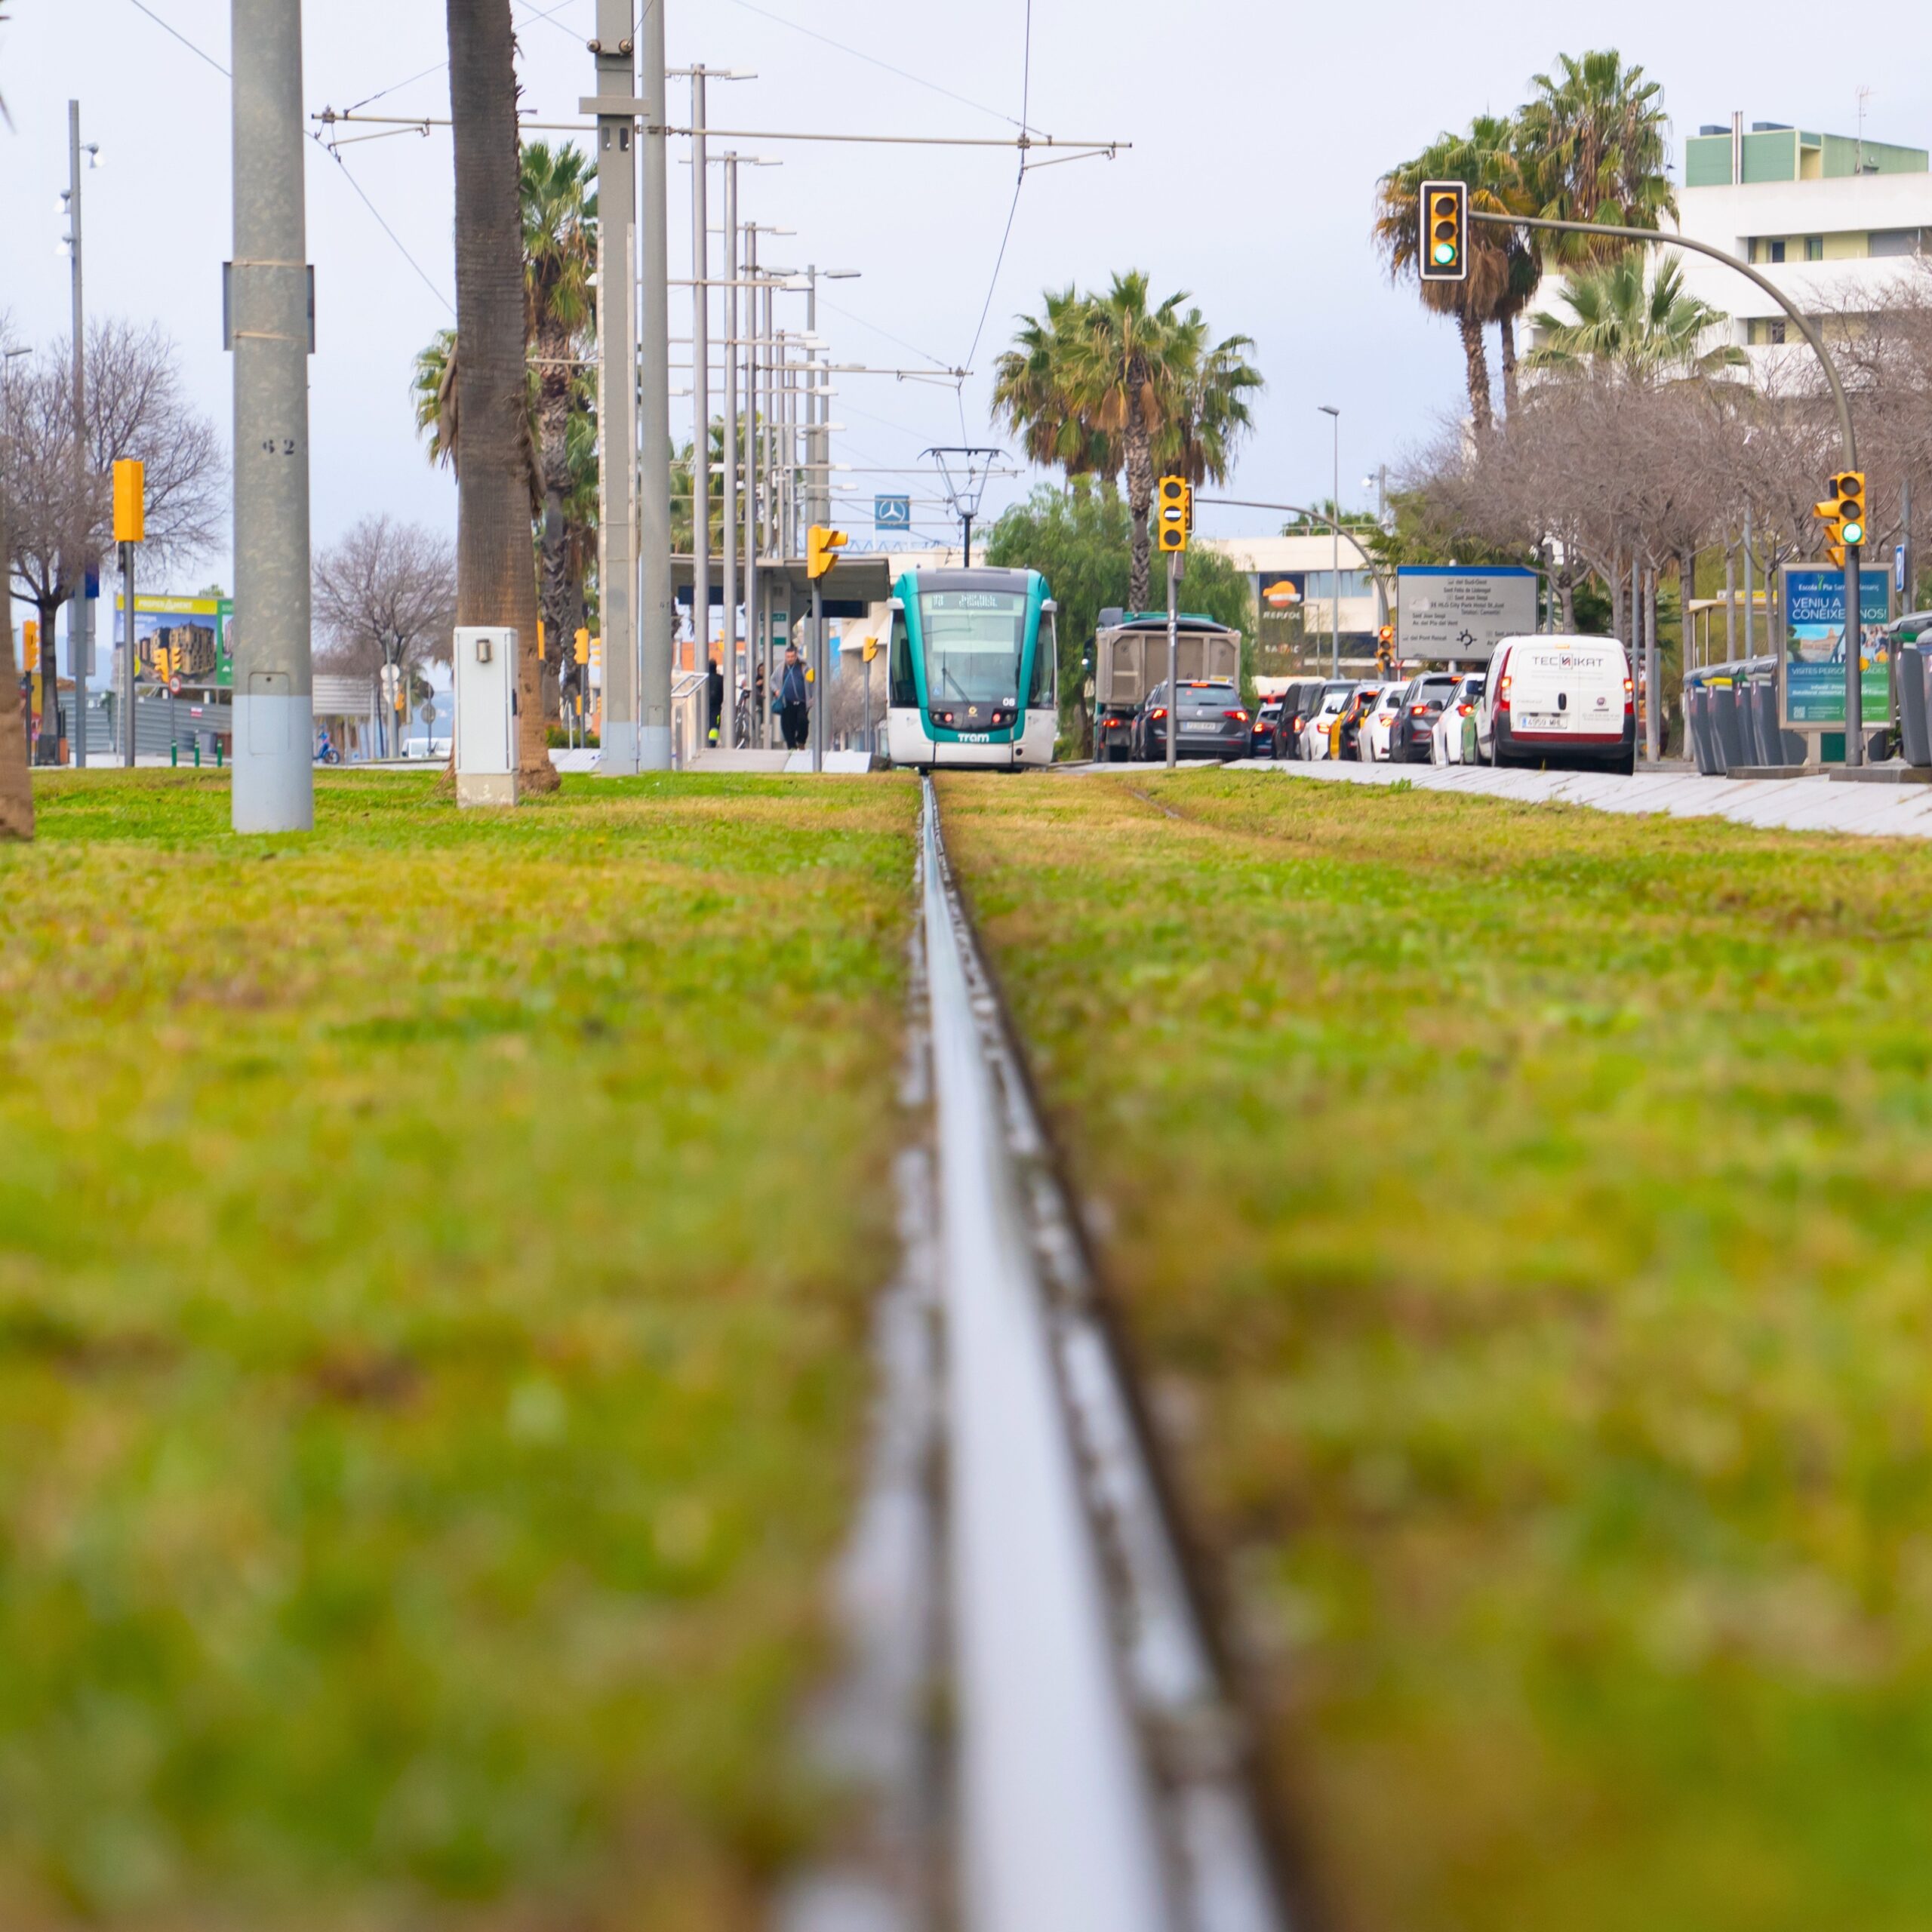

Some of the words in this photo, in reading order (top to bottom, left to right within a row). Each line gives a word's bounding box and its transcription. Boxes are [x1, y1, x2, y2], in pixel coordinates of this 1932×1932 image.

[1792, 597, 1829, 608] VENIU
[1832, 597, 1841, 608] A
[1263, 611, 1301, 620] REPSOL
